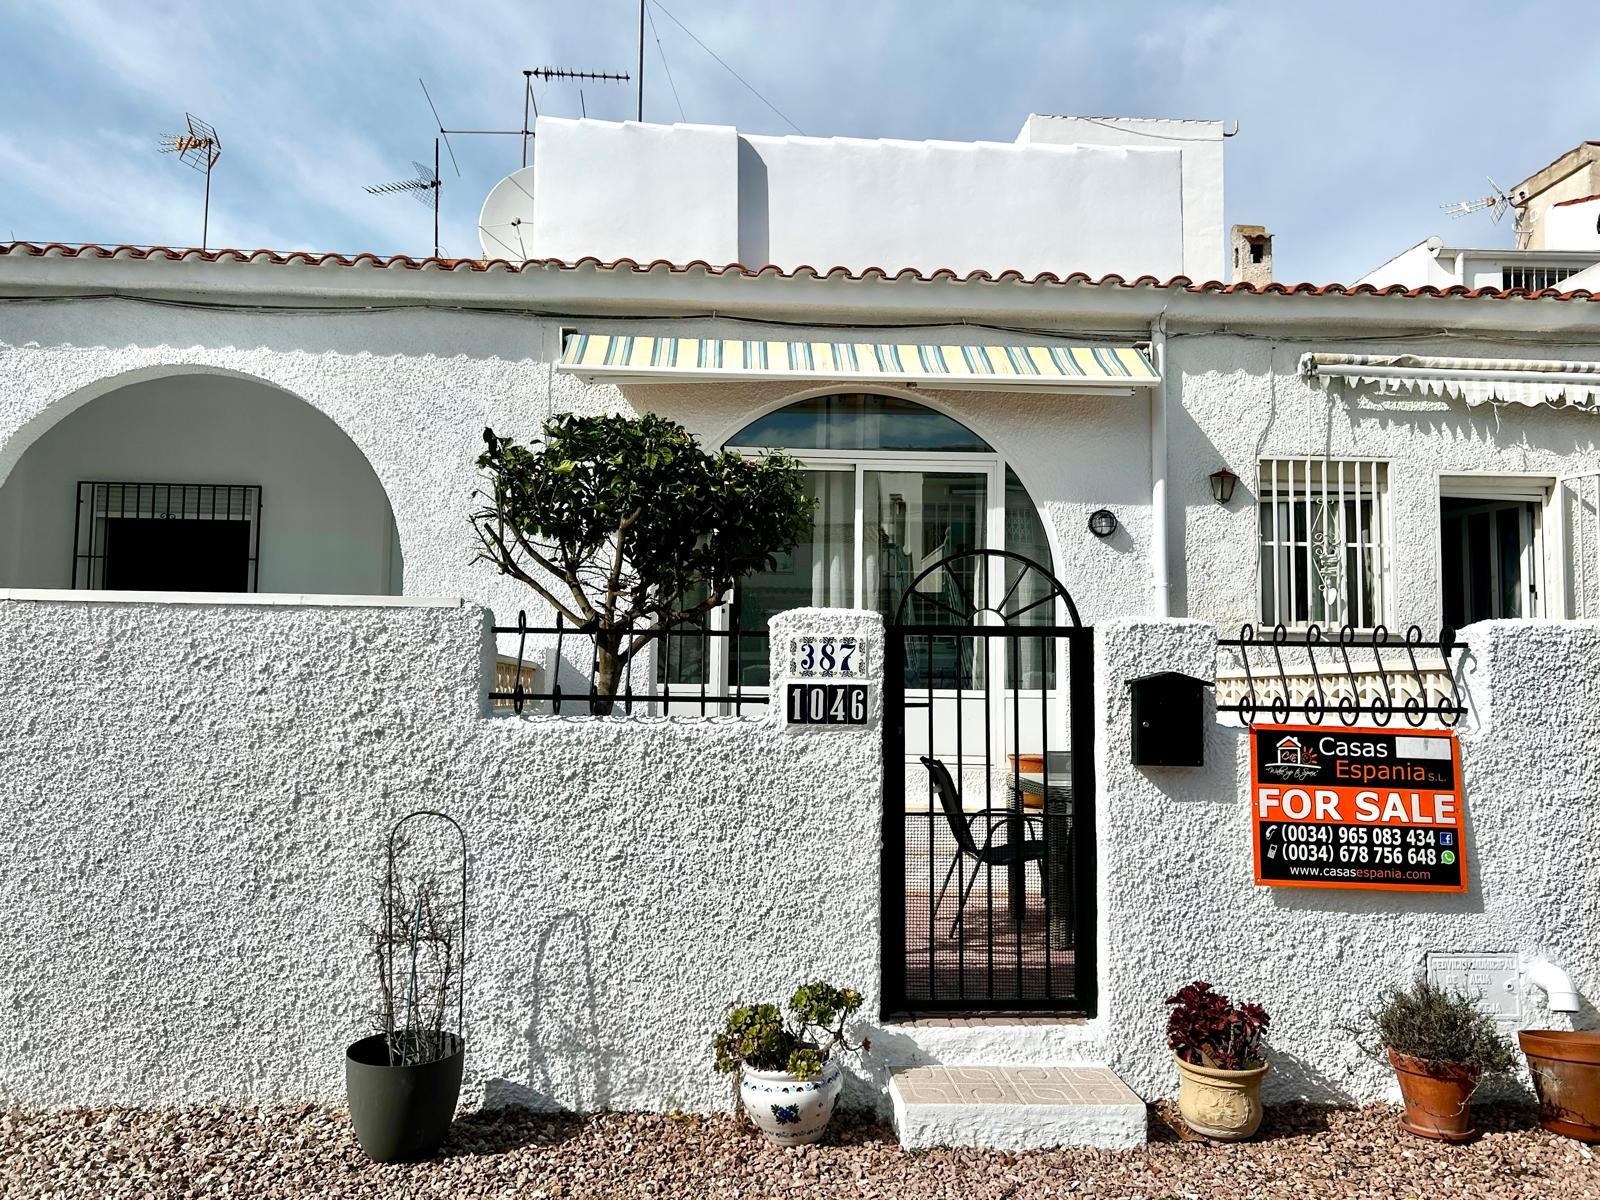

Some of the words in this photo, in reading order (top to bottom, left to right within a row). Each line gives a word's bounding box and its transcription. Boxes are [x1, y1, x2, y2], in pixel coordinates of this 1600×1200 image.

[800, 643, 856, 671] 387
[792, 688, 864, 721] 1046
[1319, 737, 1388, 757] Casas
[1336, 760, 1425, 783] Espania
[1428, 772, 1447, 782] S.L.
[1259, 788, 1343, 821] FOR
[1355, 791, 1457, 824] SALE
[1282, 824, 1333, 843] (0034)
[1338, 827, 1367, 844] 965
[1372, 828, 1401, 845] 083
[1406, 830, 1435, 846] 434
[1282, 844, 1334, 862] (0034)
[1339, 846, 1368, 863] 678
[1373, 847, 1402, 864] 756
[1407, 848, 1436, 866] 648
[1290, 866, 1430, 880] www.casasespania.com
